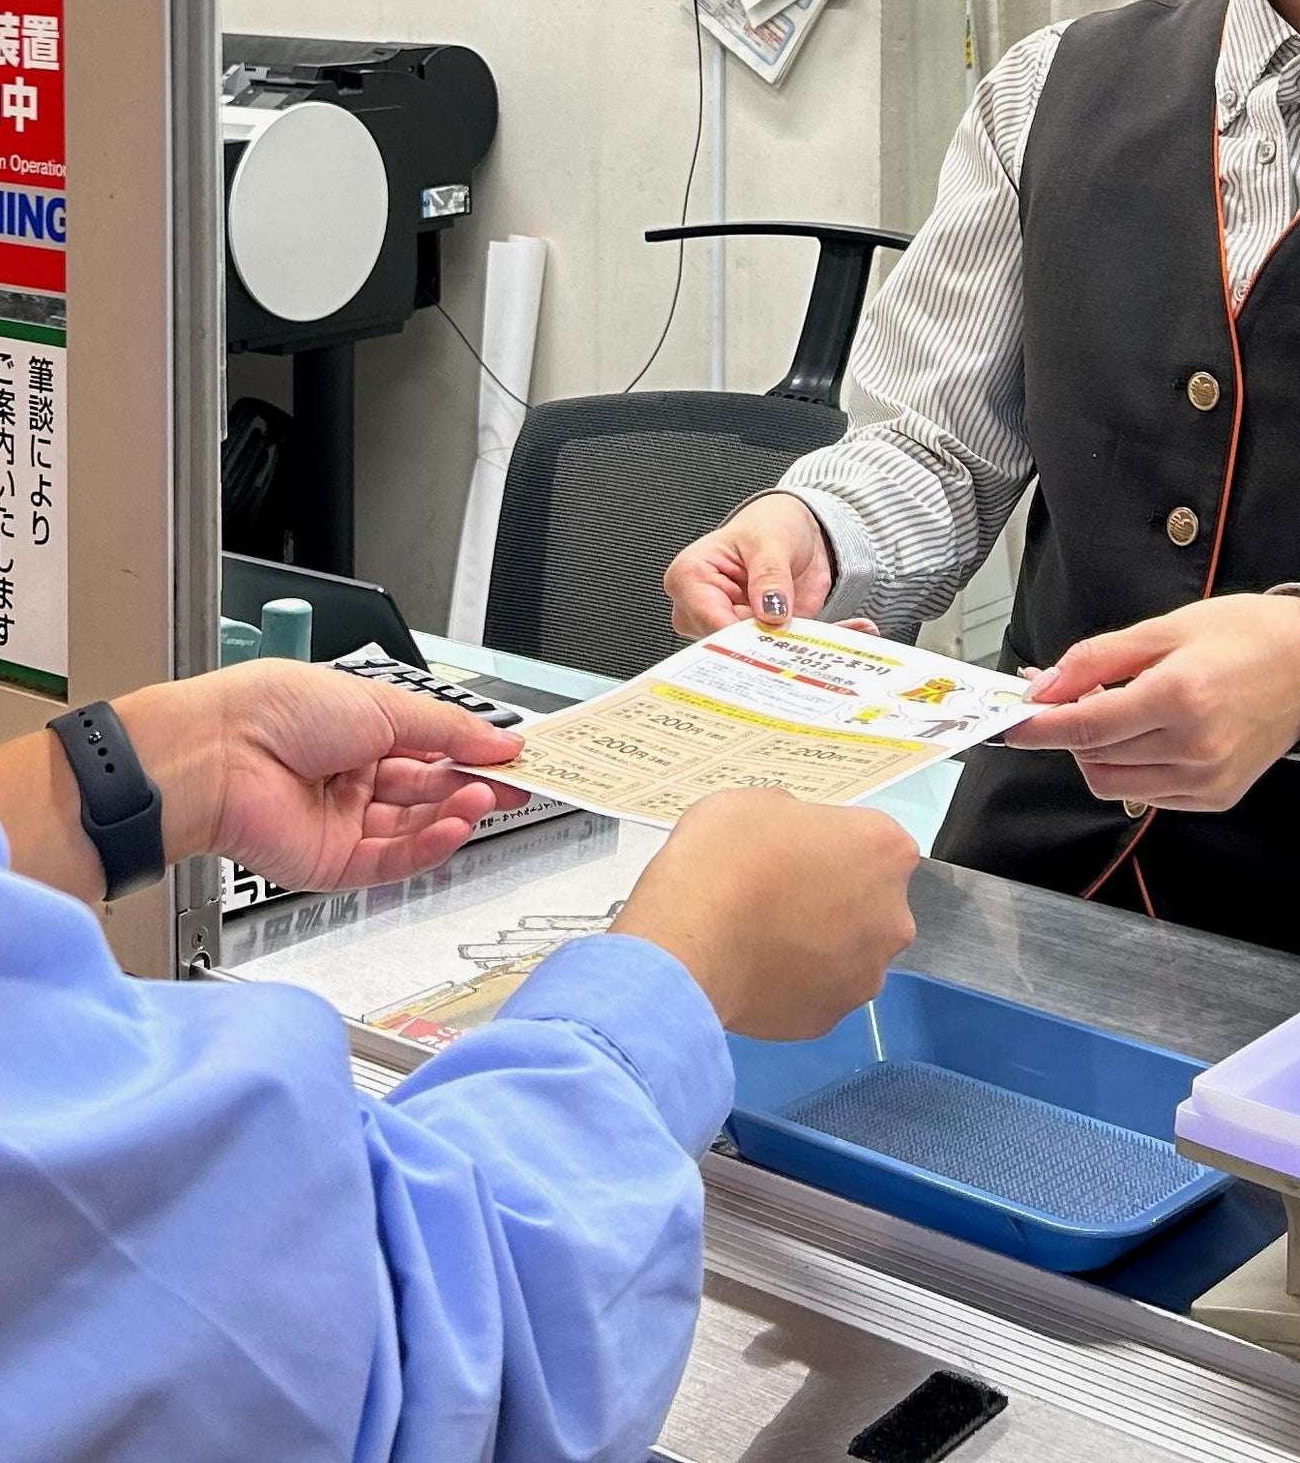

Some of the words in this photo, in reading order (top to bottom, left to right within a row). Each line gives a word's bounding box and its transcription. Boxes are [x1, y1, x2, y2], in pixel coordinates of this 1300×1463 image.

[28, 355, 55, 546] 筆談により
[650, 713, 705, 736] 200円
[592, 736, 649, 760] 200円
